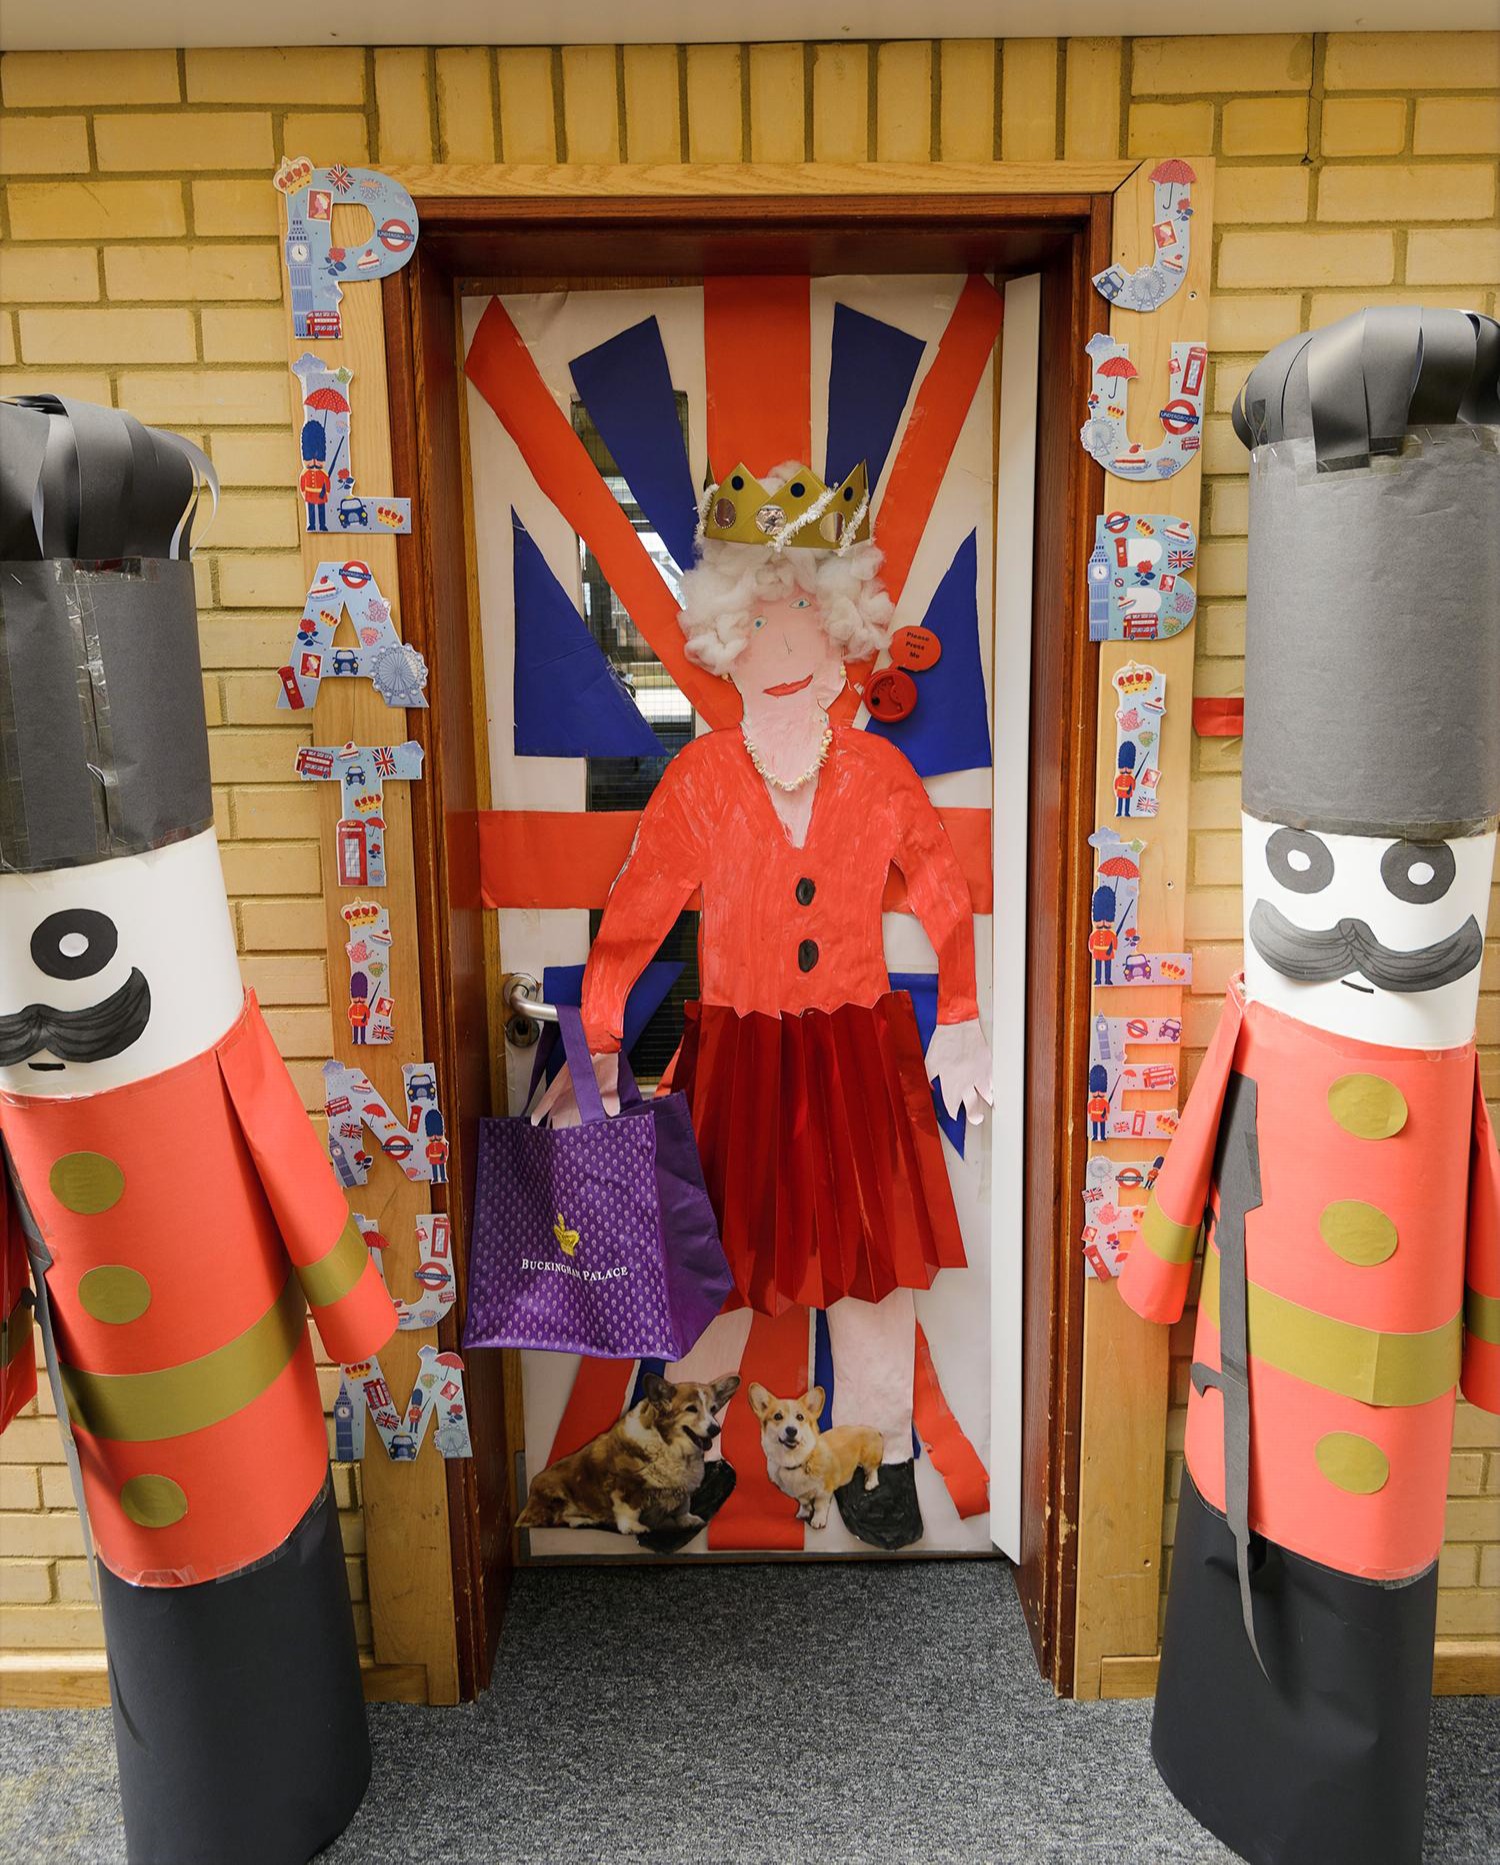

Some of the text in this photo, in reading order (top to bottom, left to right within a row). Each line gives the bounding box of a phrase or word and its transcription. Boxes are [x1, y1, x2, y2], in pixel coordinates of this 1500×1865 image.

[1160, 411, 1198, 423] UNDERGROUND
[906, 631, 930, 642] Please
[905, 641, 925, 651] Press
[909, 651, 920, 659] Me
[1080, 158, 1209, 1282] JUBILEE
[273, 156, 474, 1462] PLATINUM
[522, 1259, 629, 1281] BUCKINGHAM PALACE
